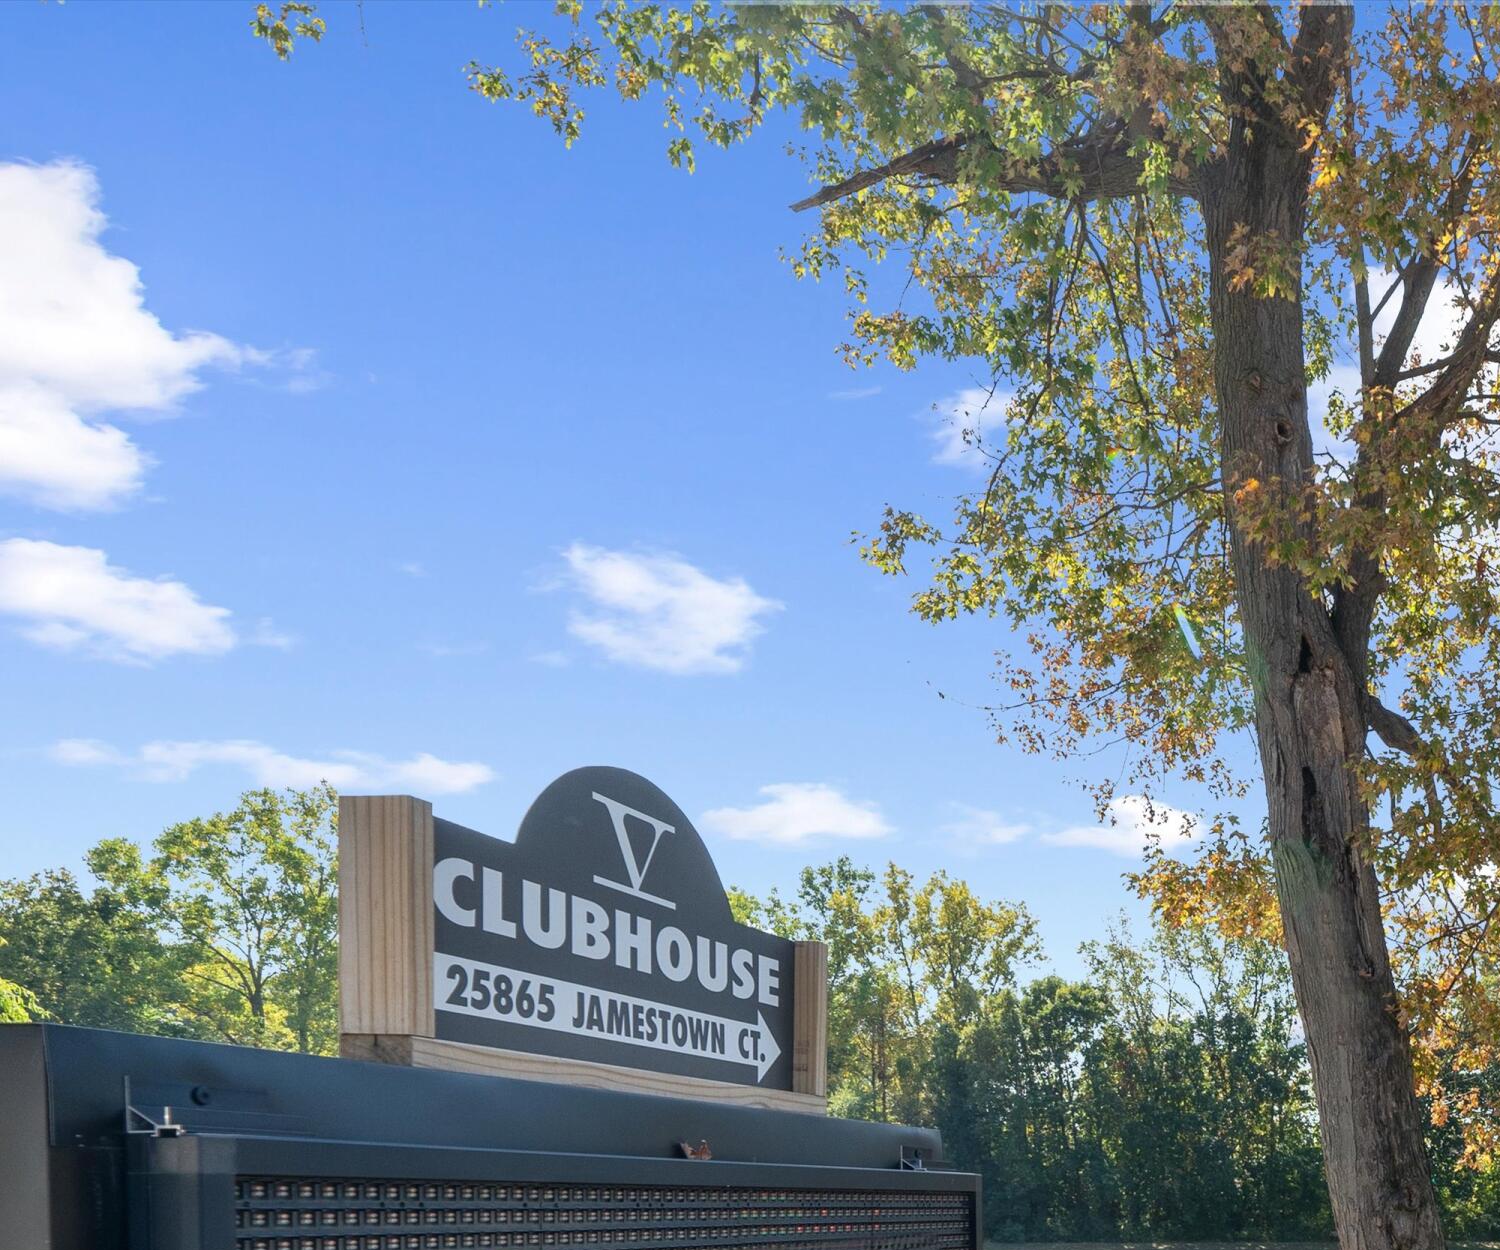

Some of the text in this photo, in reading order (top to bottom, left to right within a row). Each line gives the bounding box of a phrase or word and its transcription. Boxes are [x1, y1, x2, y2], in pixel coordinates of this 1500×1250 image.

[592, 791, 676, 910] V
[433, 857, 780, 1007] CLUBHOUSE
[445, 963, 556, 1023] 25865
[572, 991, 726, 1055] JAMESTOWN
[737, 1028, 767, 1063] CT.
